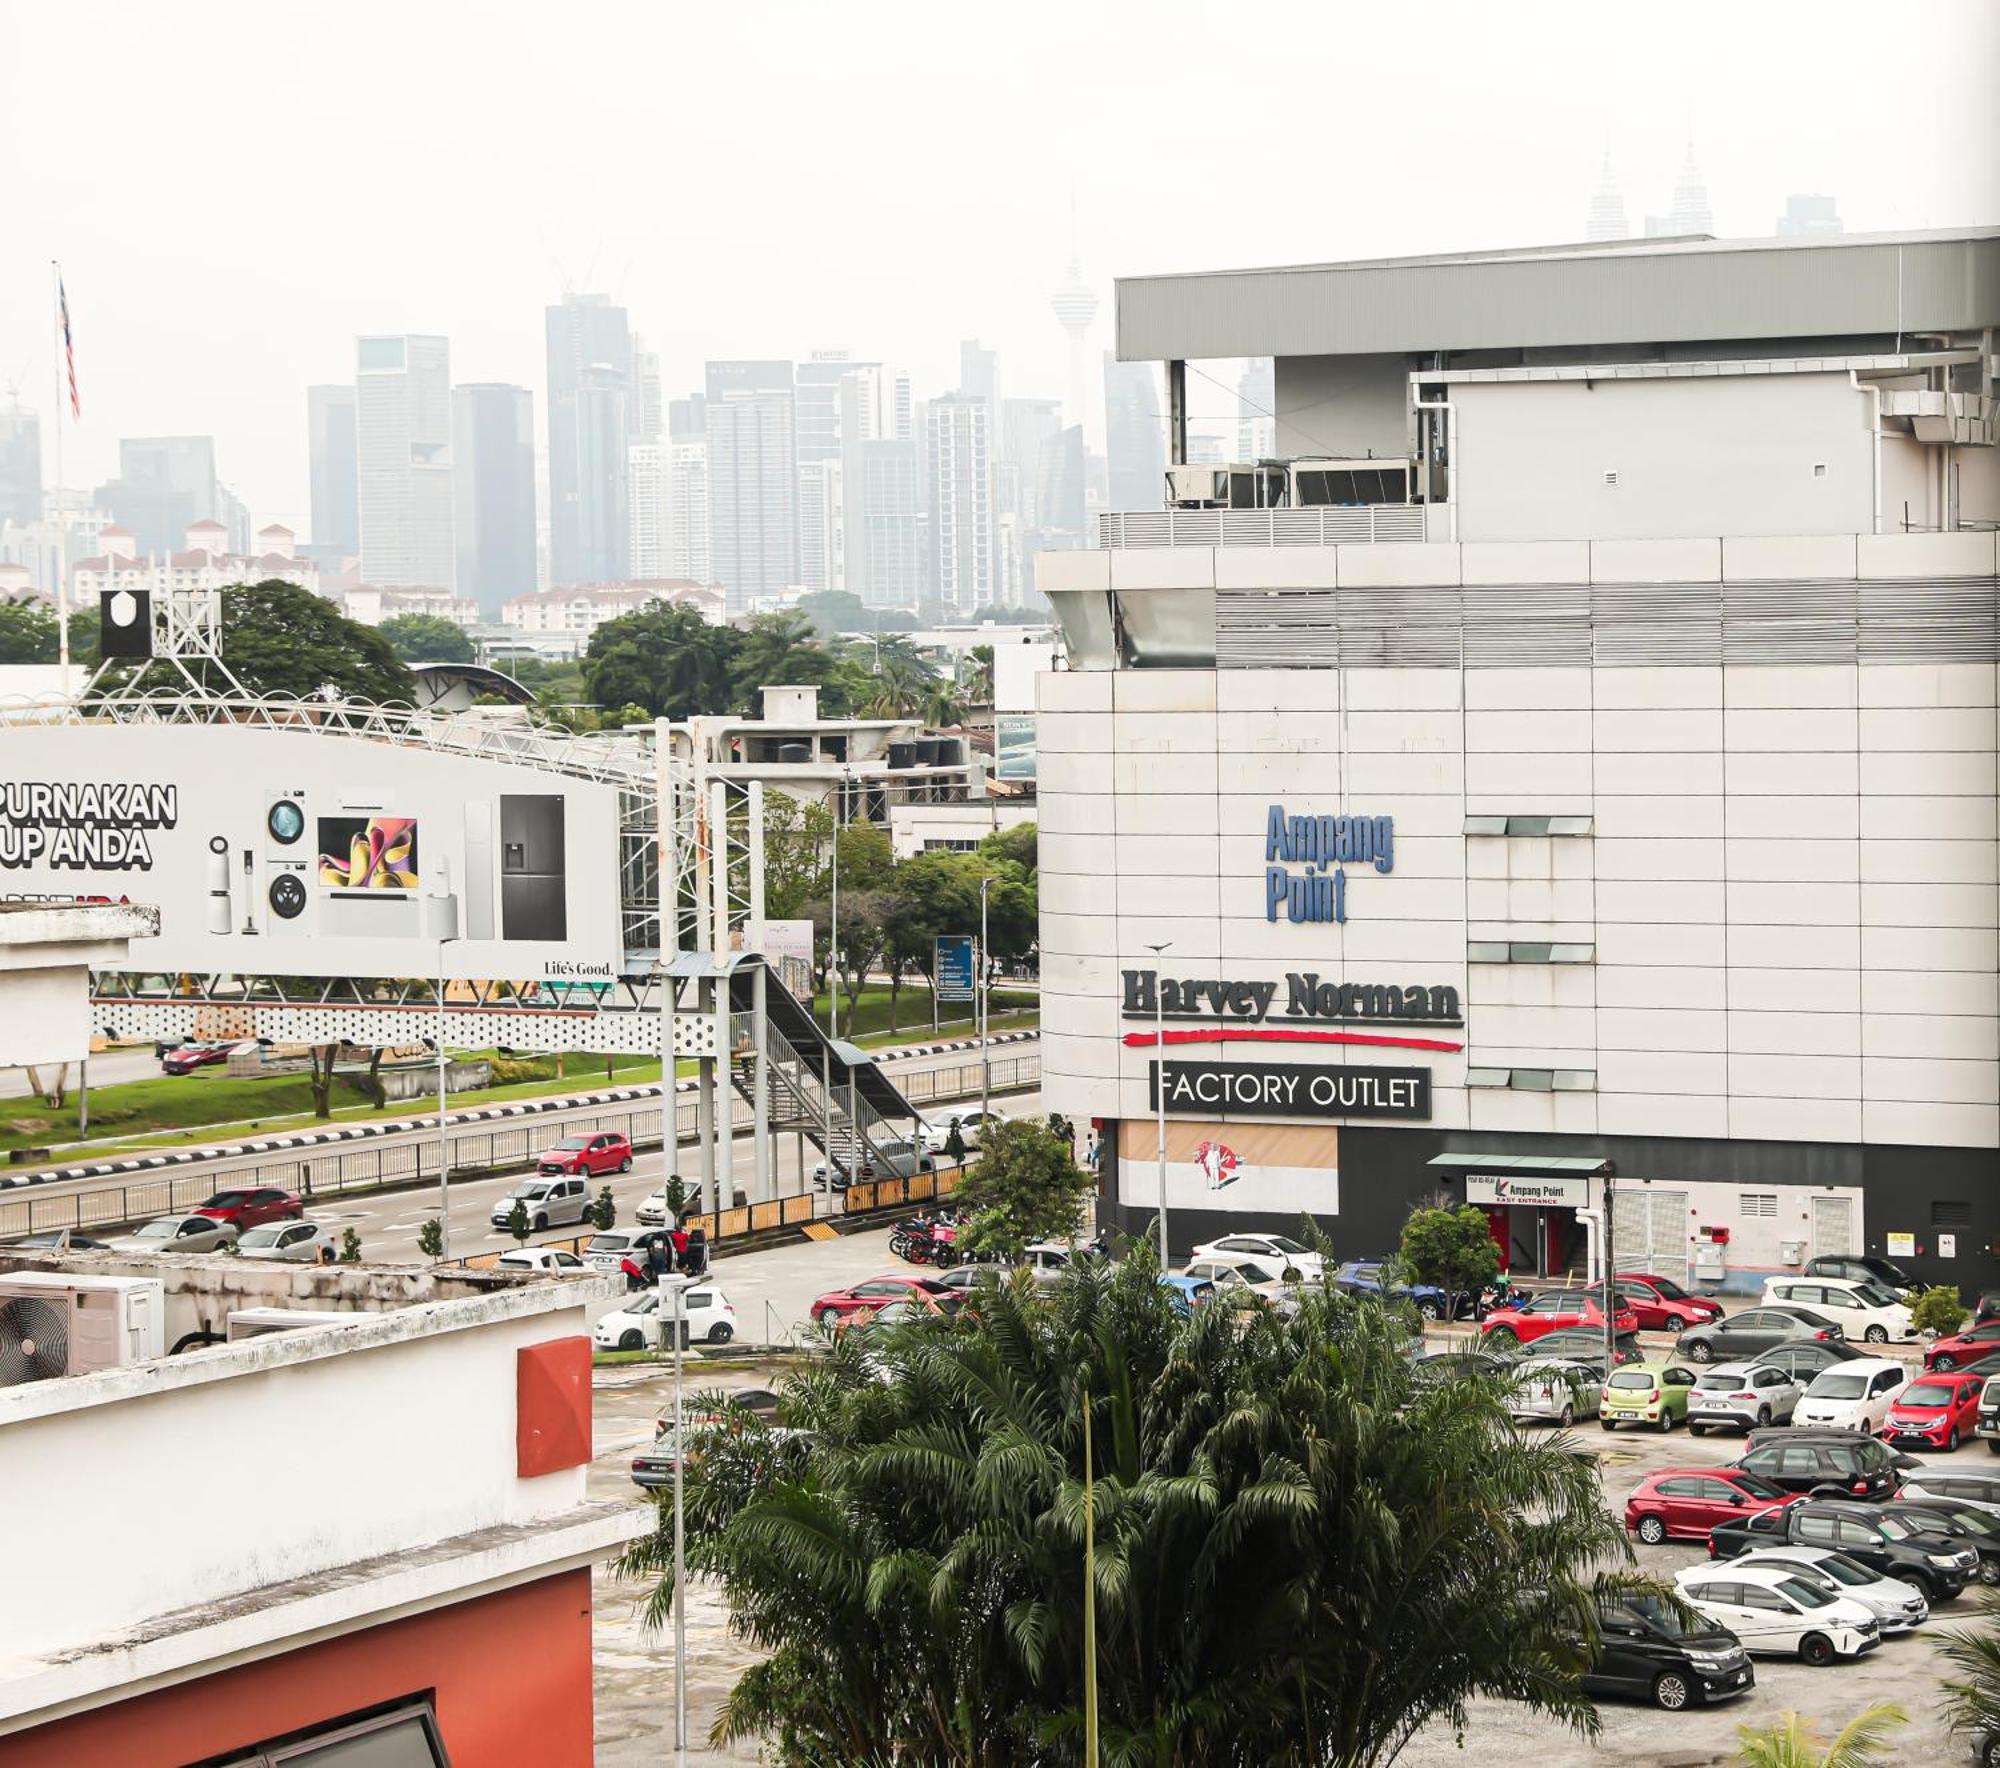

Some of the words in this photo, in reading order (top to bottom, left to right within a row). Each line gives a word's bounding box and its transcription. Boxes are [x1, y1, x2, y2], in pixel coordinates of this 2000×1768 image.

[50, 827, 153, 871] ANDA
[1266, 805, 1393, 874] Ampang
[1266, 866, 1347, 924] Point
[545, 962, 574, 976] Life's
[577, 963, 614, 977] Good.
[1121, 970, 1277, 1024] Harvey
[1285, 972, 1462, 1020] Norman
[1309, 1076, 1419, 1108] OUTLET
[1510, 1185, 1541, 1197] Ampang
[1543, 1186, 1564, 1197] Point
